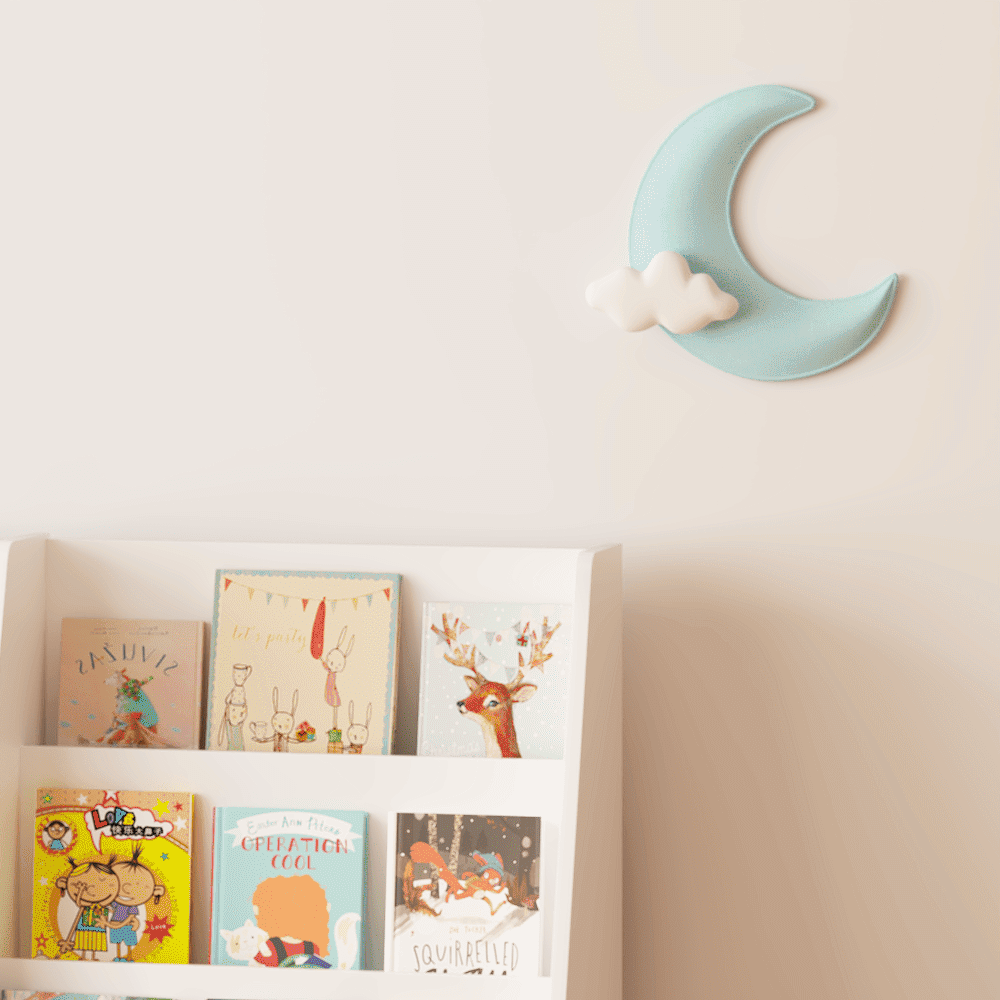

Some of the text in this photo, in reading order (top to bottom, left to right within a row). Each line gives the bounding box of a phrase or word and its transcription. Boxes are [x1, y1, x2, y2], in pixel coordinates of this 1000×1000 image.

[241, 836, 349, 854] OPERATION
[270, 854, 316, 870] COOL
[413, 940, 519, 973] SQUIRRELLED
